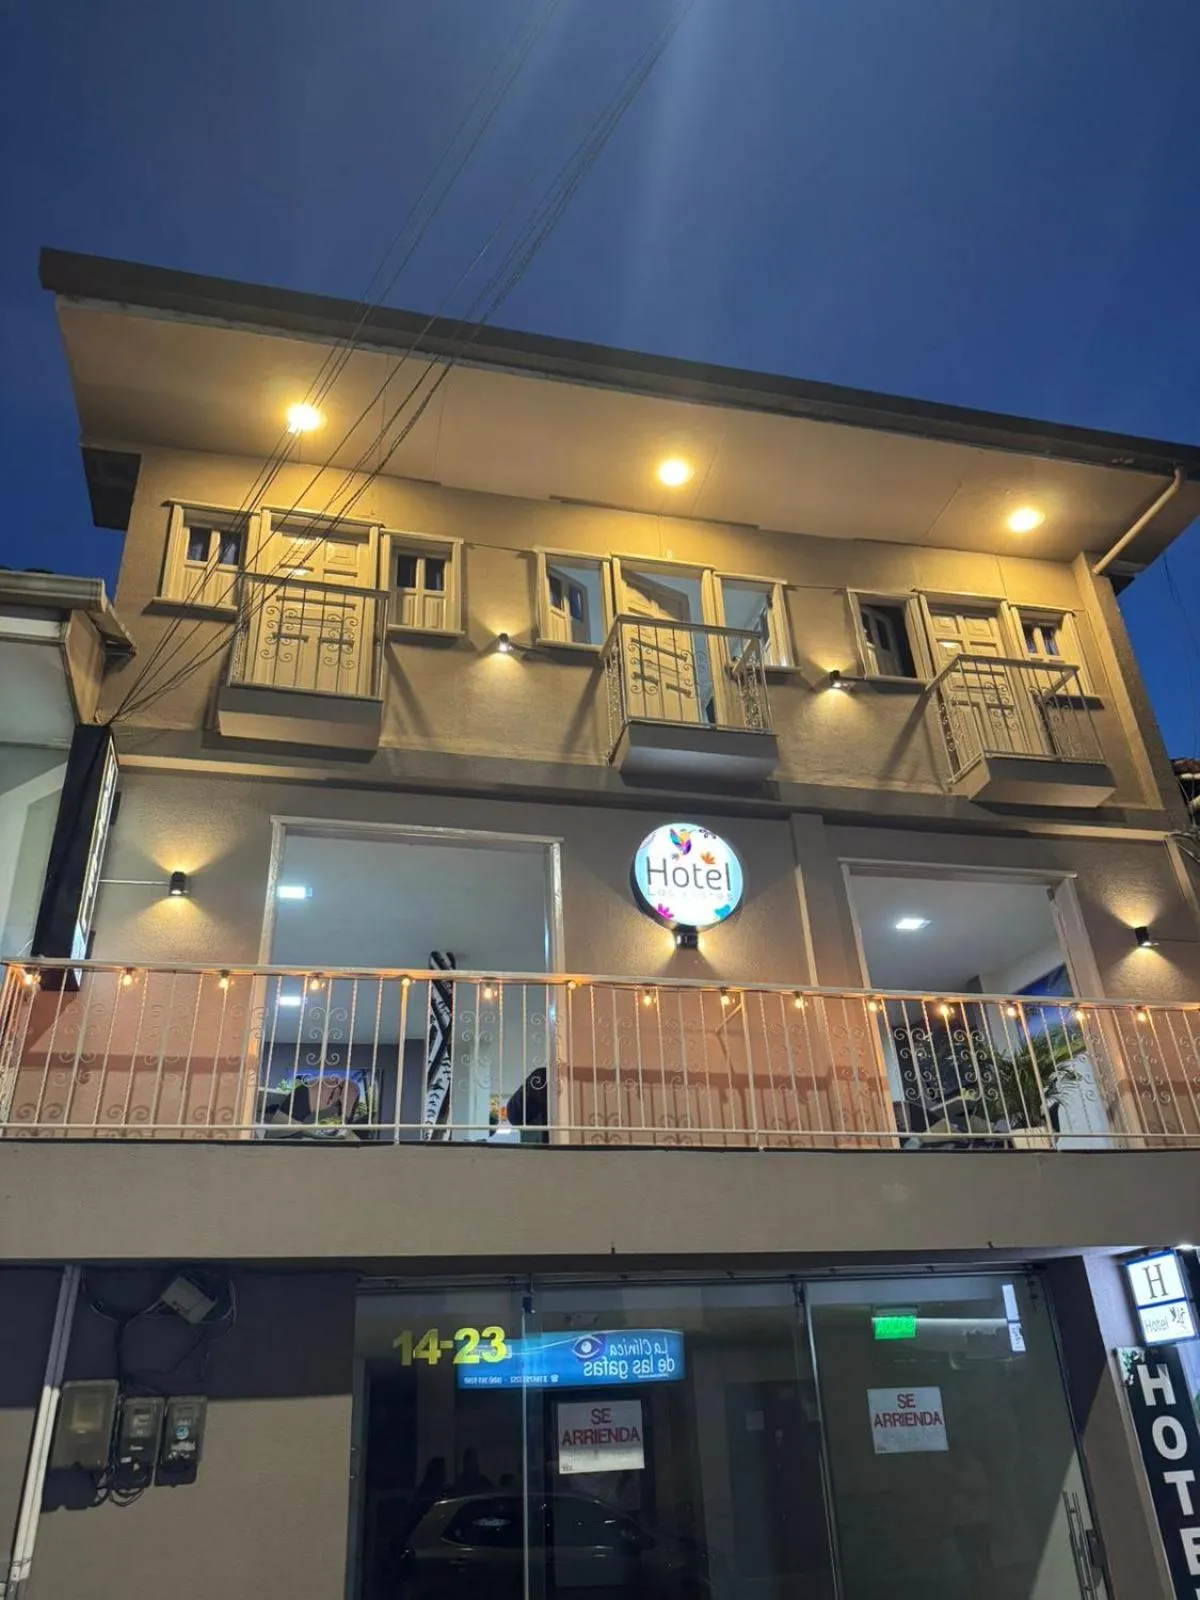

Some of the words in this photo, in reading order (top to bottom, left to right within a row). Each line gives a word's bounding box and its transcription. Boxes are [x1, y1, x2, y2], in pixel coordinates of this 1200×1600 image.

[646, 856, 731, 891] Hotel
[1142, 1263, 1169, 1299] H
[392, 1326, 507, 1366] 14-23
[897, 1393, 916, 1409] SE
[591, 1408, 611, 1425] SE
[874, 1411, 943, 1428] ARRIENDA
[562, 1426, 641, 1446] ARRIENDA
